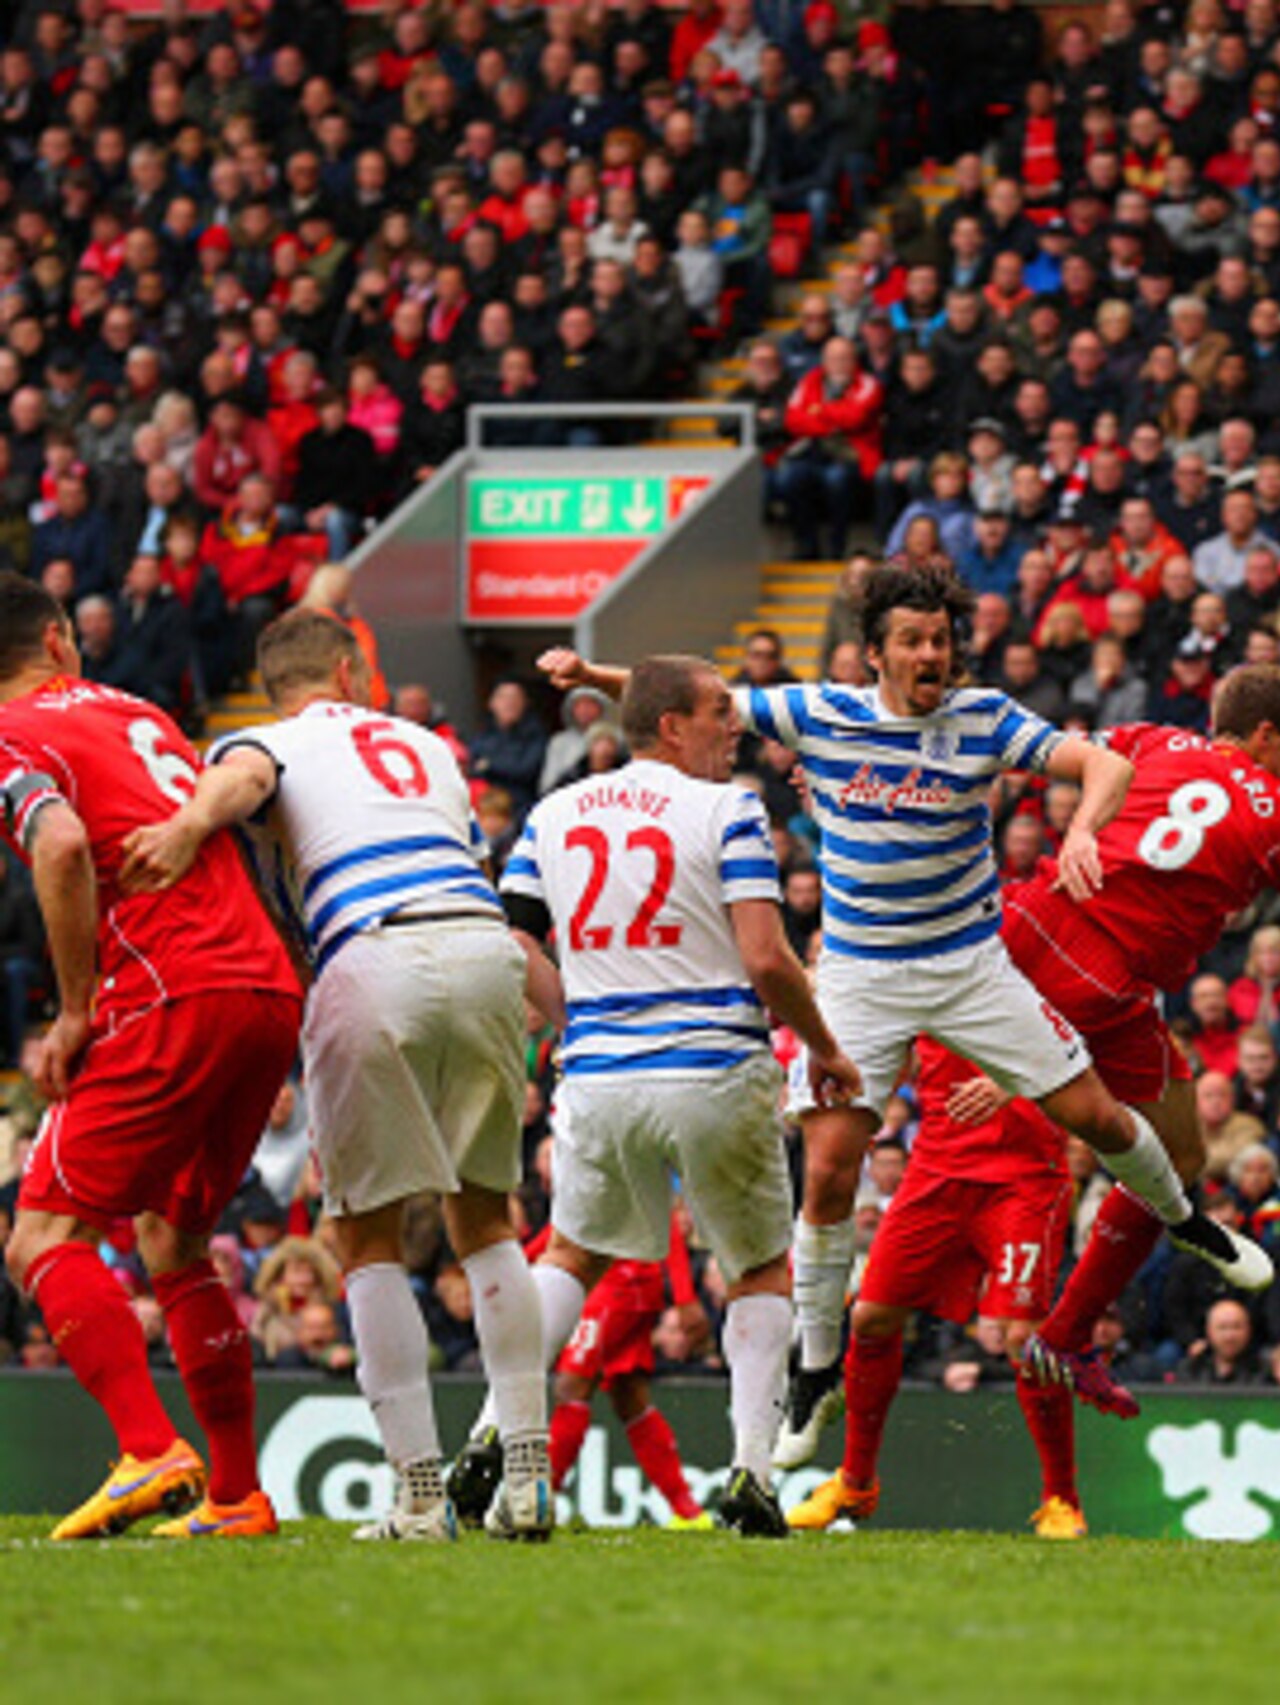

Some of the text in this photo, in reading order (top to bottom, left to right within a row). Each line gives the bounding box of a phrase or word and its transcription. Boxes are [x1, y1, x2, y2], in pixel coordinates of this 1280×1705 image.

[479, 488, 568, 527] EXIT
[477, 571, 577, 597] Standard
[127, 716, 197, 805] 6
[350, 720, 430, 799] 6
[1137, 778, 1232, 871] 8
[564, 824, 683, 952] 22
